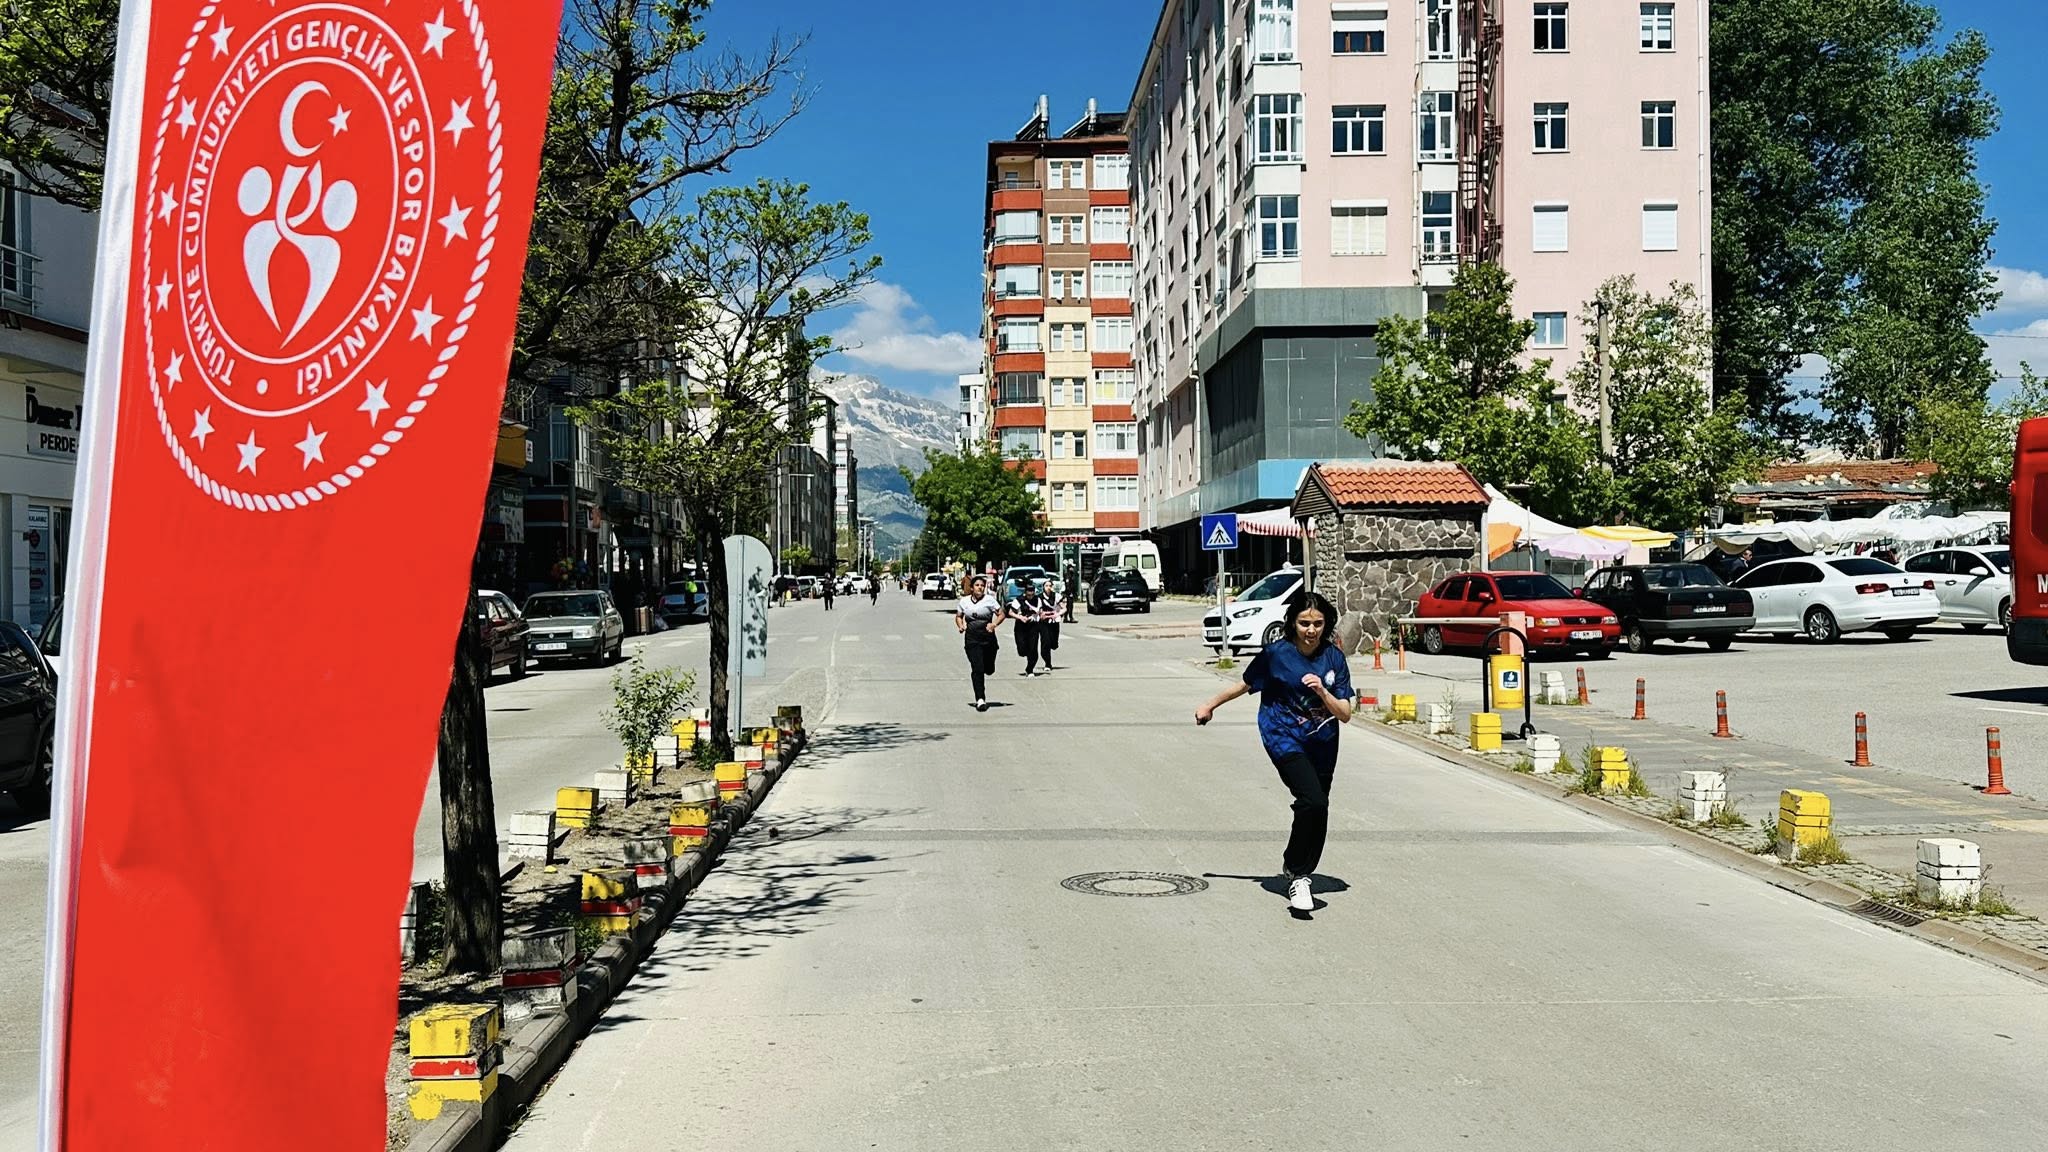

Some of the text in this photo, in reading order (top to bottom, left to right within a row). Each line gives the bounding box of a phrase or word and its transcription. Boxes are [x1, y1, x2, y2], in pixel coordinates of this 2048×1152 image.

[186, 20, 424, 395] TÜRKİYE CUMHURİYETİ GENÇLİK VE SPOR BAKANLIĞI
[40, 432, 76, 454] PERDE
